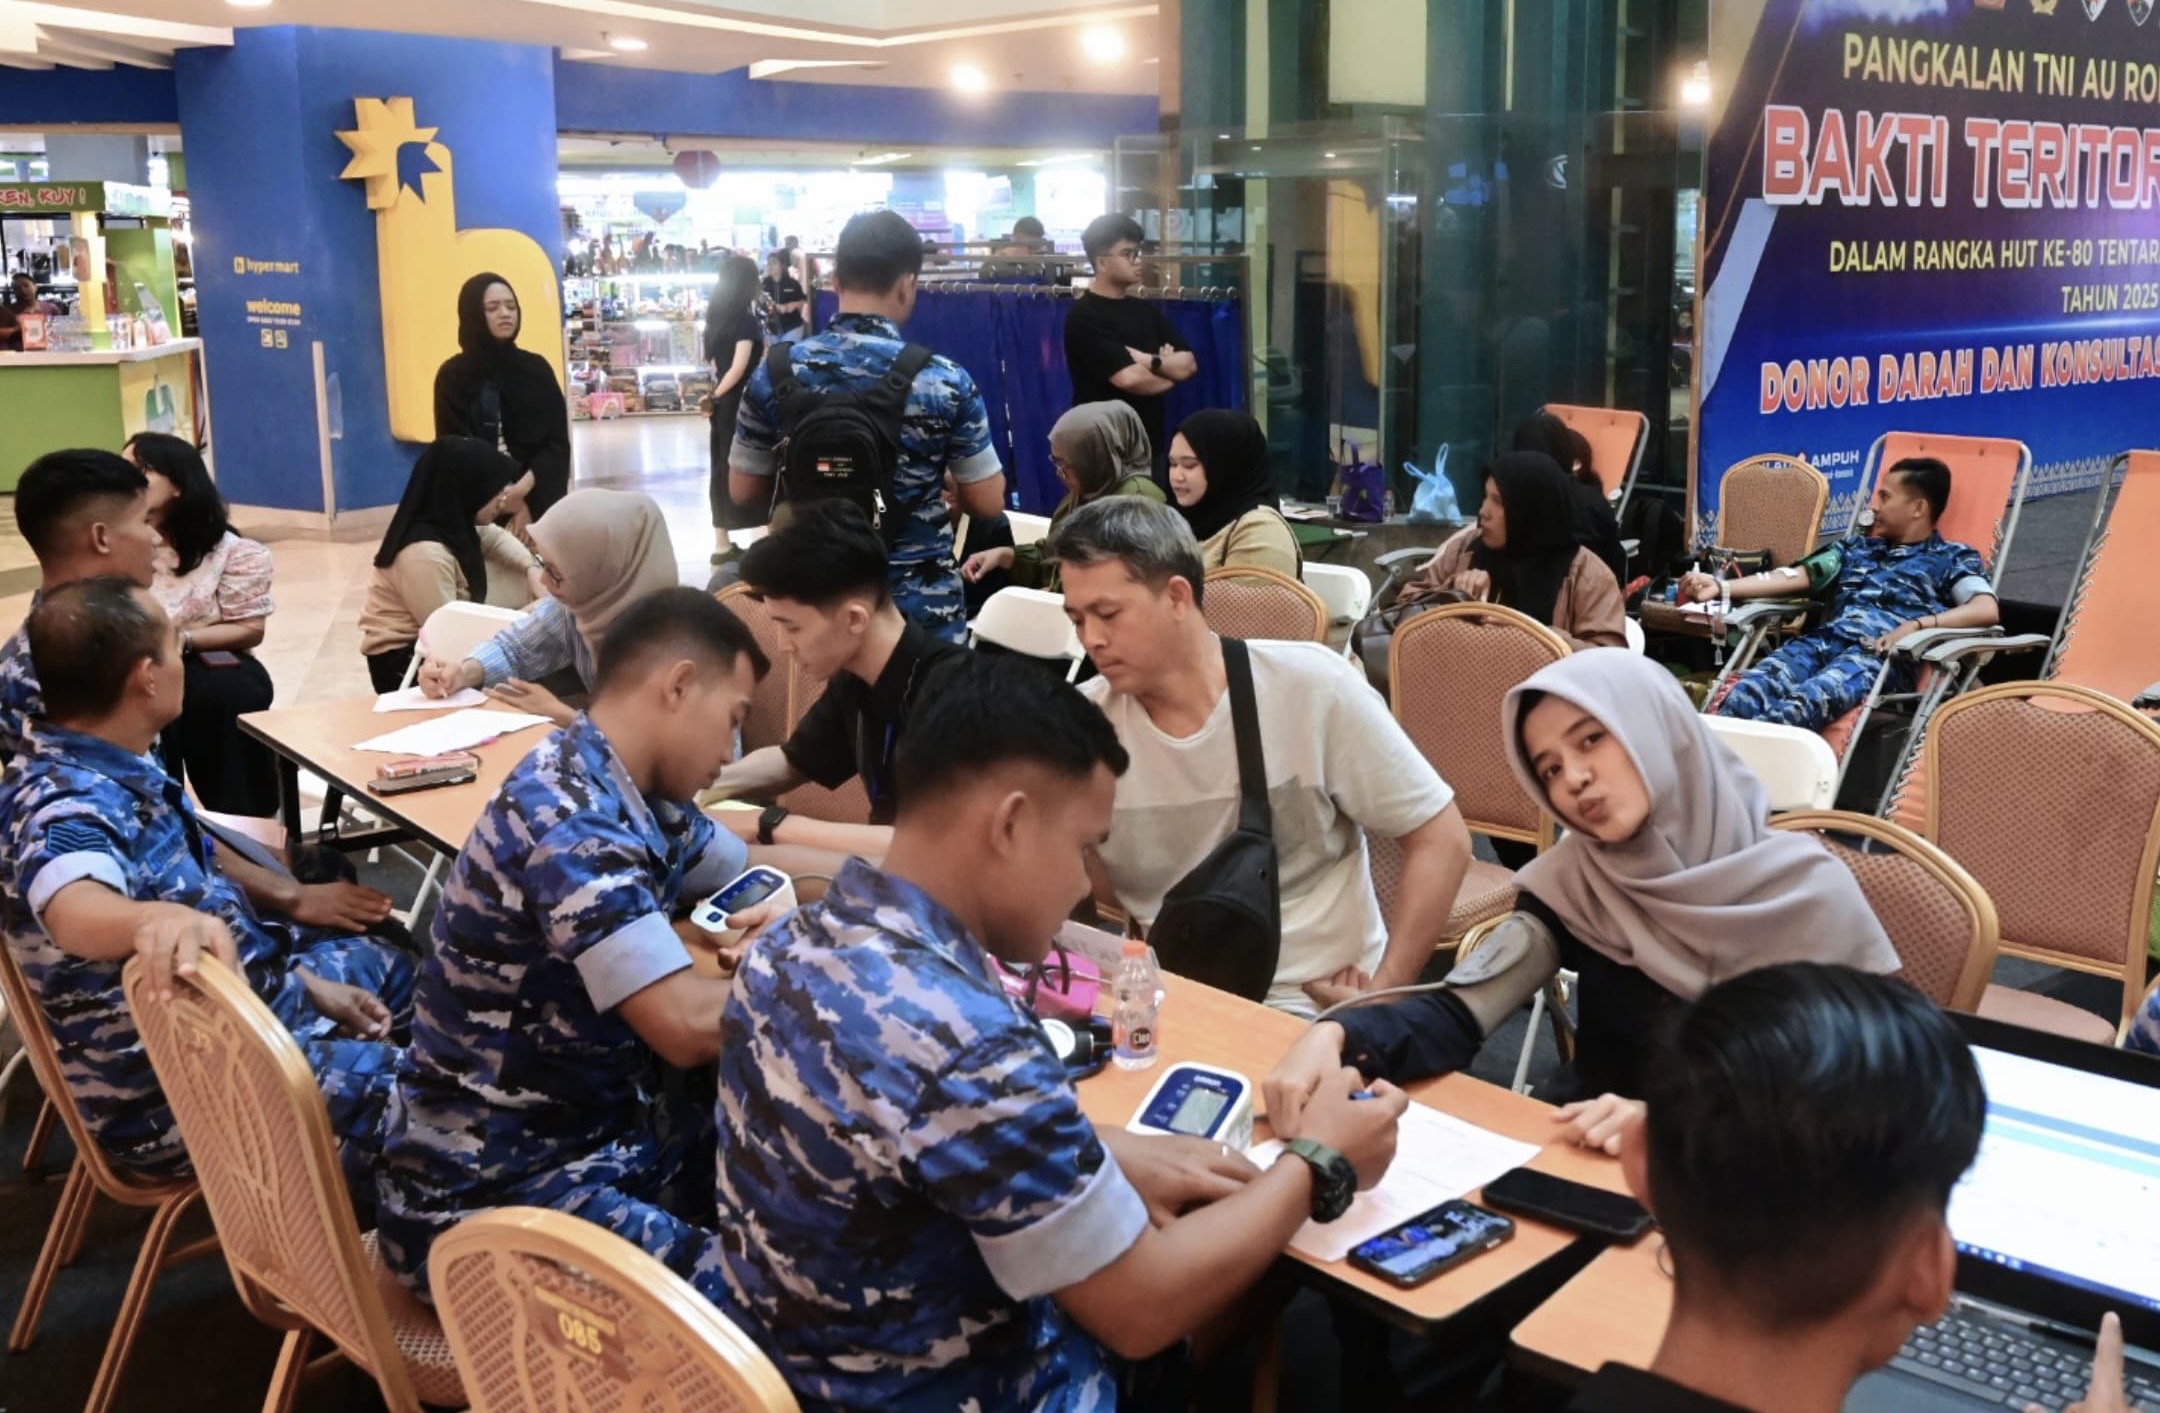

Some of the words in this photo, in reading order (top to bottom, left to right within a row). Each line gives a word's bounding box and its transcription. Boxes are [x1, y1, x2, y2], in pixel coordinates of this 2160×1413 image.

[1843, 33, 2025, 93] PANGKALAN
[2033, 53, 2075, 96] TNI
[2081, 58, 2116, 100] AU
[2124, 62, 2160, 104] RO
[1762, 104, 1949, 207] BAKTI
[1964, 117, 2160, 209] TERITOR
[1829, 241, 1906, 272] DALAM
[1914, 240, 1995, 271] RANGKA
[2002, 240, 2037, 269] HUT
[2043, 239, 2093, 267] KE-80
[2098, 238, 2160, 265] TENTAR
[246, 298, 301, 316] welcome
[2061, 284, 2119, 314] TAHUN
[2122, 282, 2159, 311] 2025
[1760, 356, 1870, 414] DONOR
[1877, 348, 1974, 404] DARAH
[1981, 343, 2034, 394] DAN
[1811, 449, 1860, 468] AMPUH
